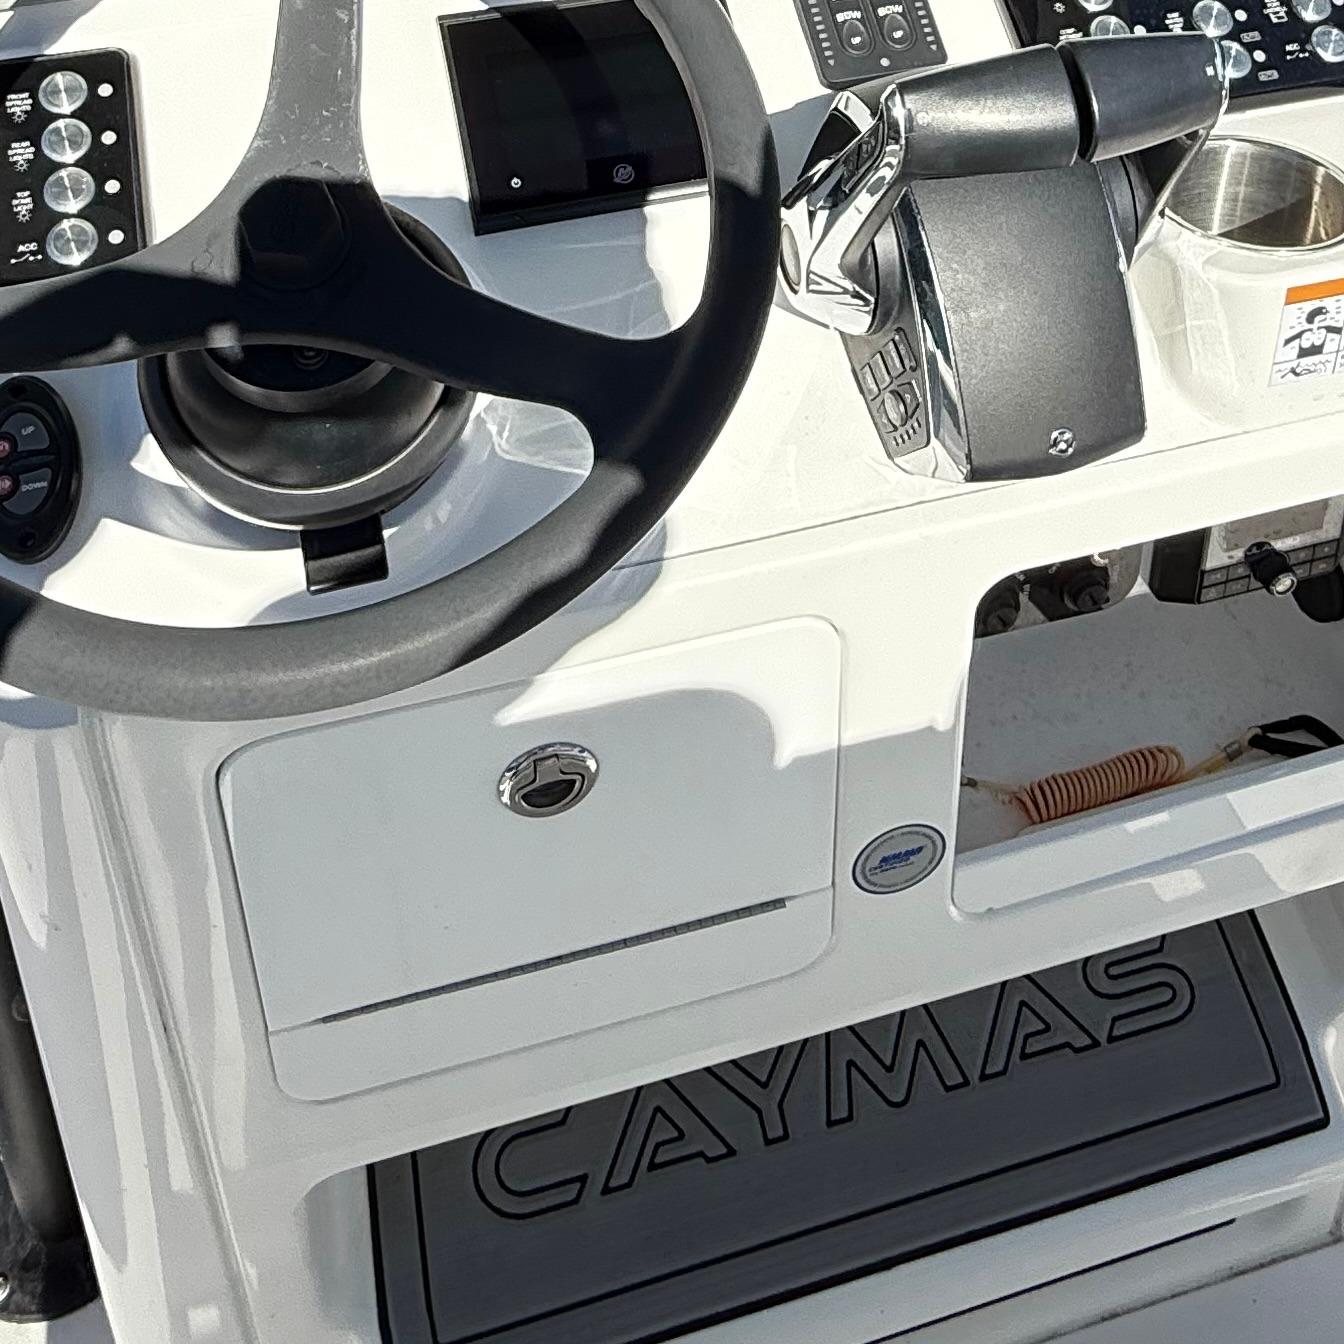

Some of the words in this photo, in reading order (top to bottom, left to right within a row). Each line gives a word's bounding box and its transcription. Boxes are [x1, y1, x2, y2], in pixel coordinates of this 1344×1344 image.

[892, 30, 904, 39] UP
[850, 36, 862, 45] UP
[17, 242, 38, 252] ACC
[21, 425, 36, 436] UP
[21, 481, 48, 492] DOWN
[472, 933, 1199, 1220] CAYMAS
